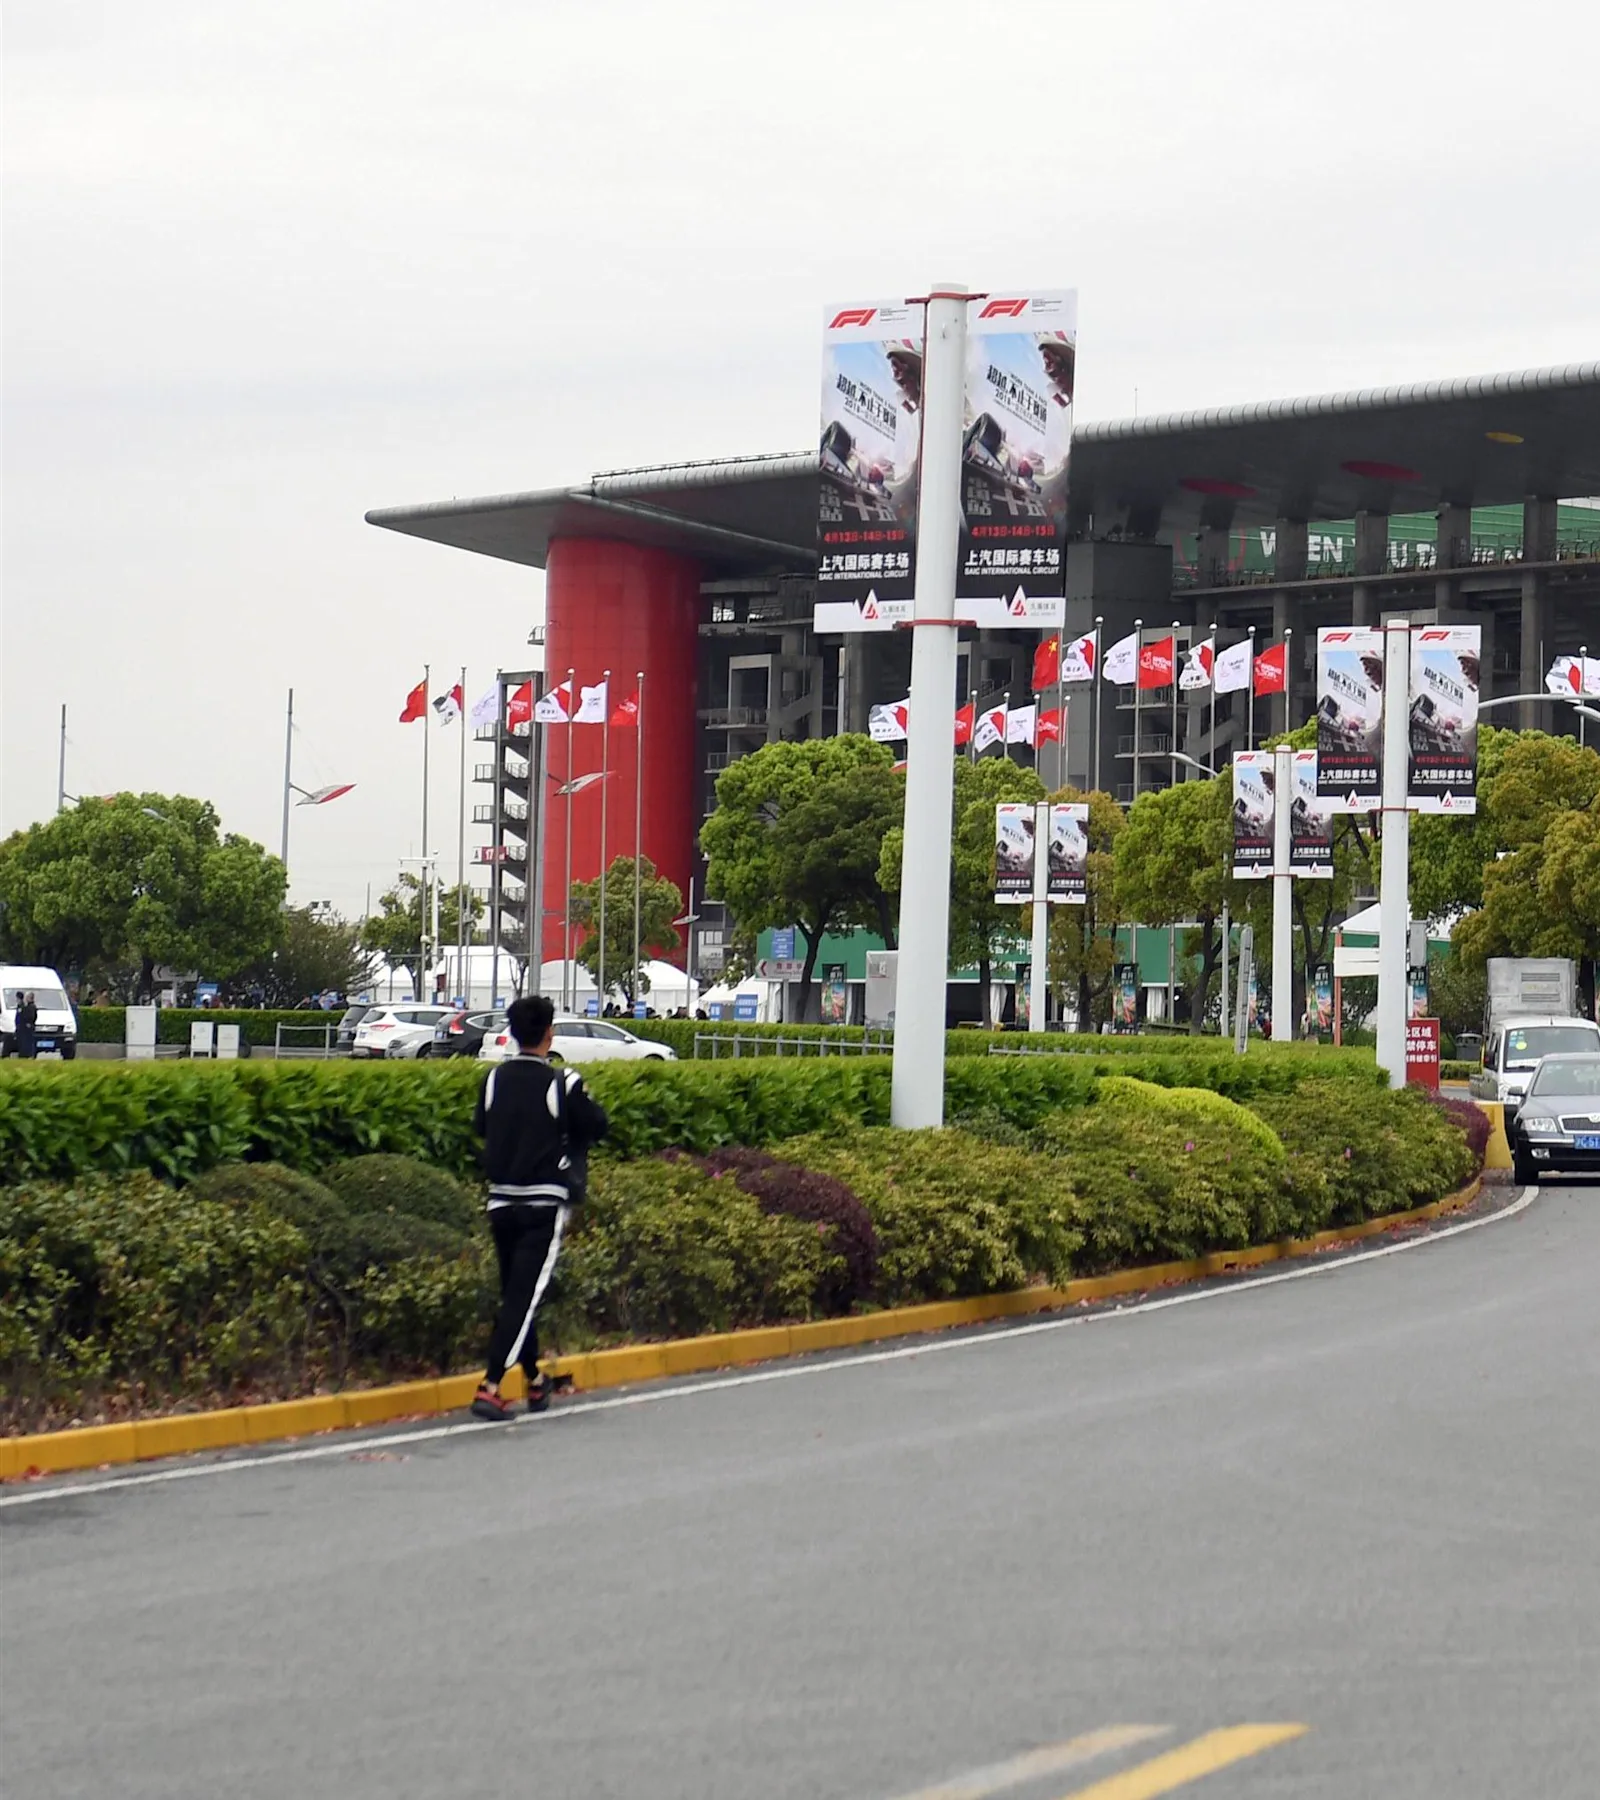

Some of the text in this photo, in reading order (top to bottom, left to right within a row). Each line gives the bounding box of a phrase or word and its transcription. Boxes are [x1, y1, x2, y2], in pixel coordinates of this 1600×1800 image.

[979, 299, 1030, 318] F1
[829, 309, 877, 328] F1
[1260, 531, 1343, 562] WEN
[818, 552, 909, 571] 上汽国际赛车场
[965, 548, 1060, 566] 上汽国际赛车场
[818, 569, 909, 581] SAIC INTERNATIONAL CIRCUIT
[964, 566, 1059, 575] SAIC INTERNATIONAL CIRCUIT
[1323, 632, 1352, 642] F1
[1419, 631, 1450, 641] F1
[1318, 769, 1377, 779] 上汽国际赛车场
[1412, 769, 1473, 779] 上汽国际赛车场
